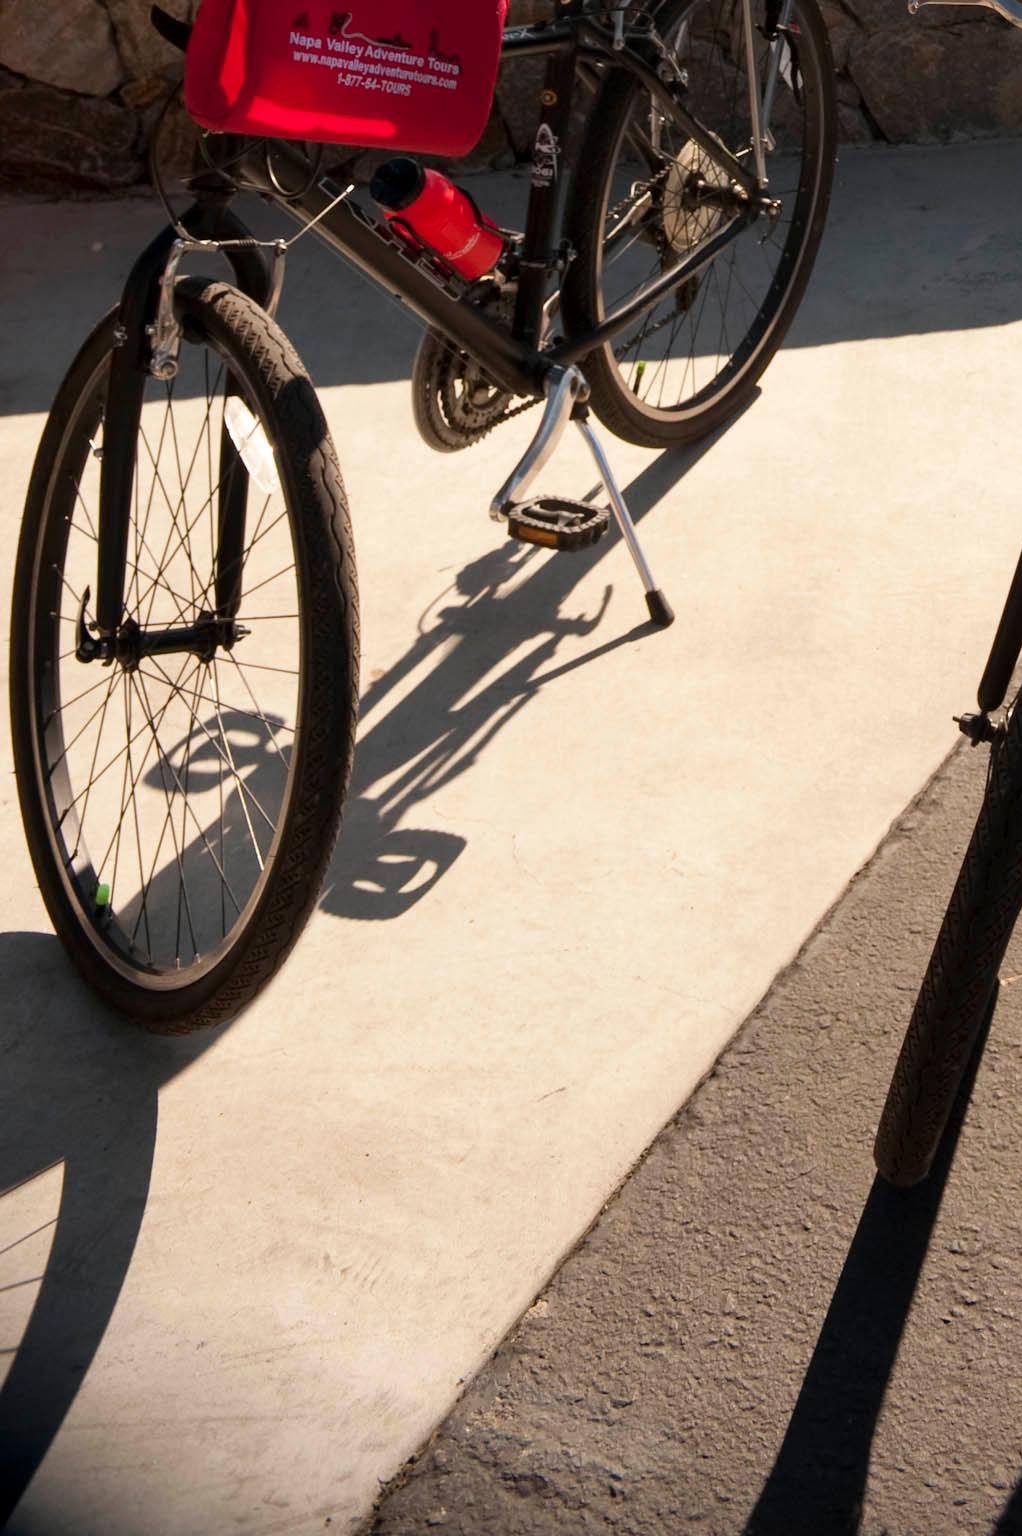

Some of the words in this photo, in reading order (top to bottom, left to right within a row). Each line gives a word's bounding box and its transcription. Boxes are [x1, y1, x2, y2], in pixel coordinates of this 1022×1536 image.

[289, 31, 322, 51] Napa
[327, 37, 365, 58] Valley
[365, 45, 425, 68] Adventure
[428, 57, 460, 76] Tours
[293, 51, 457, 90] www.napavalleyadventuretours.com
